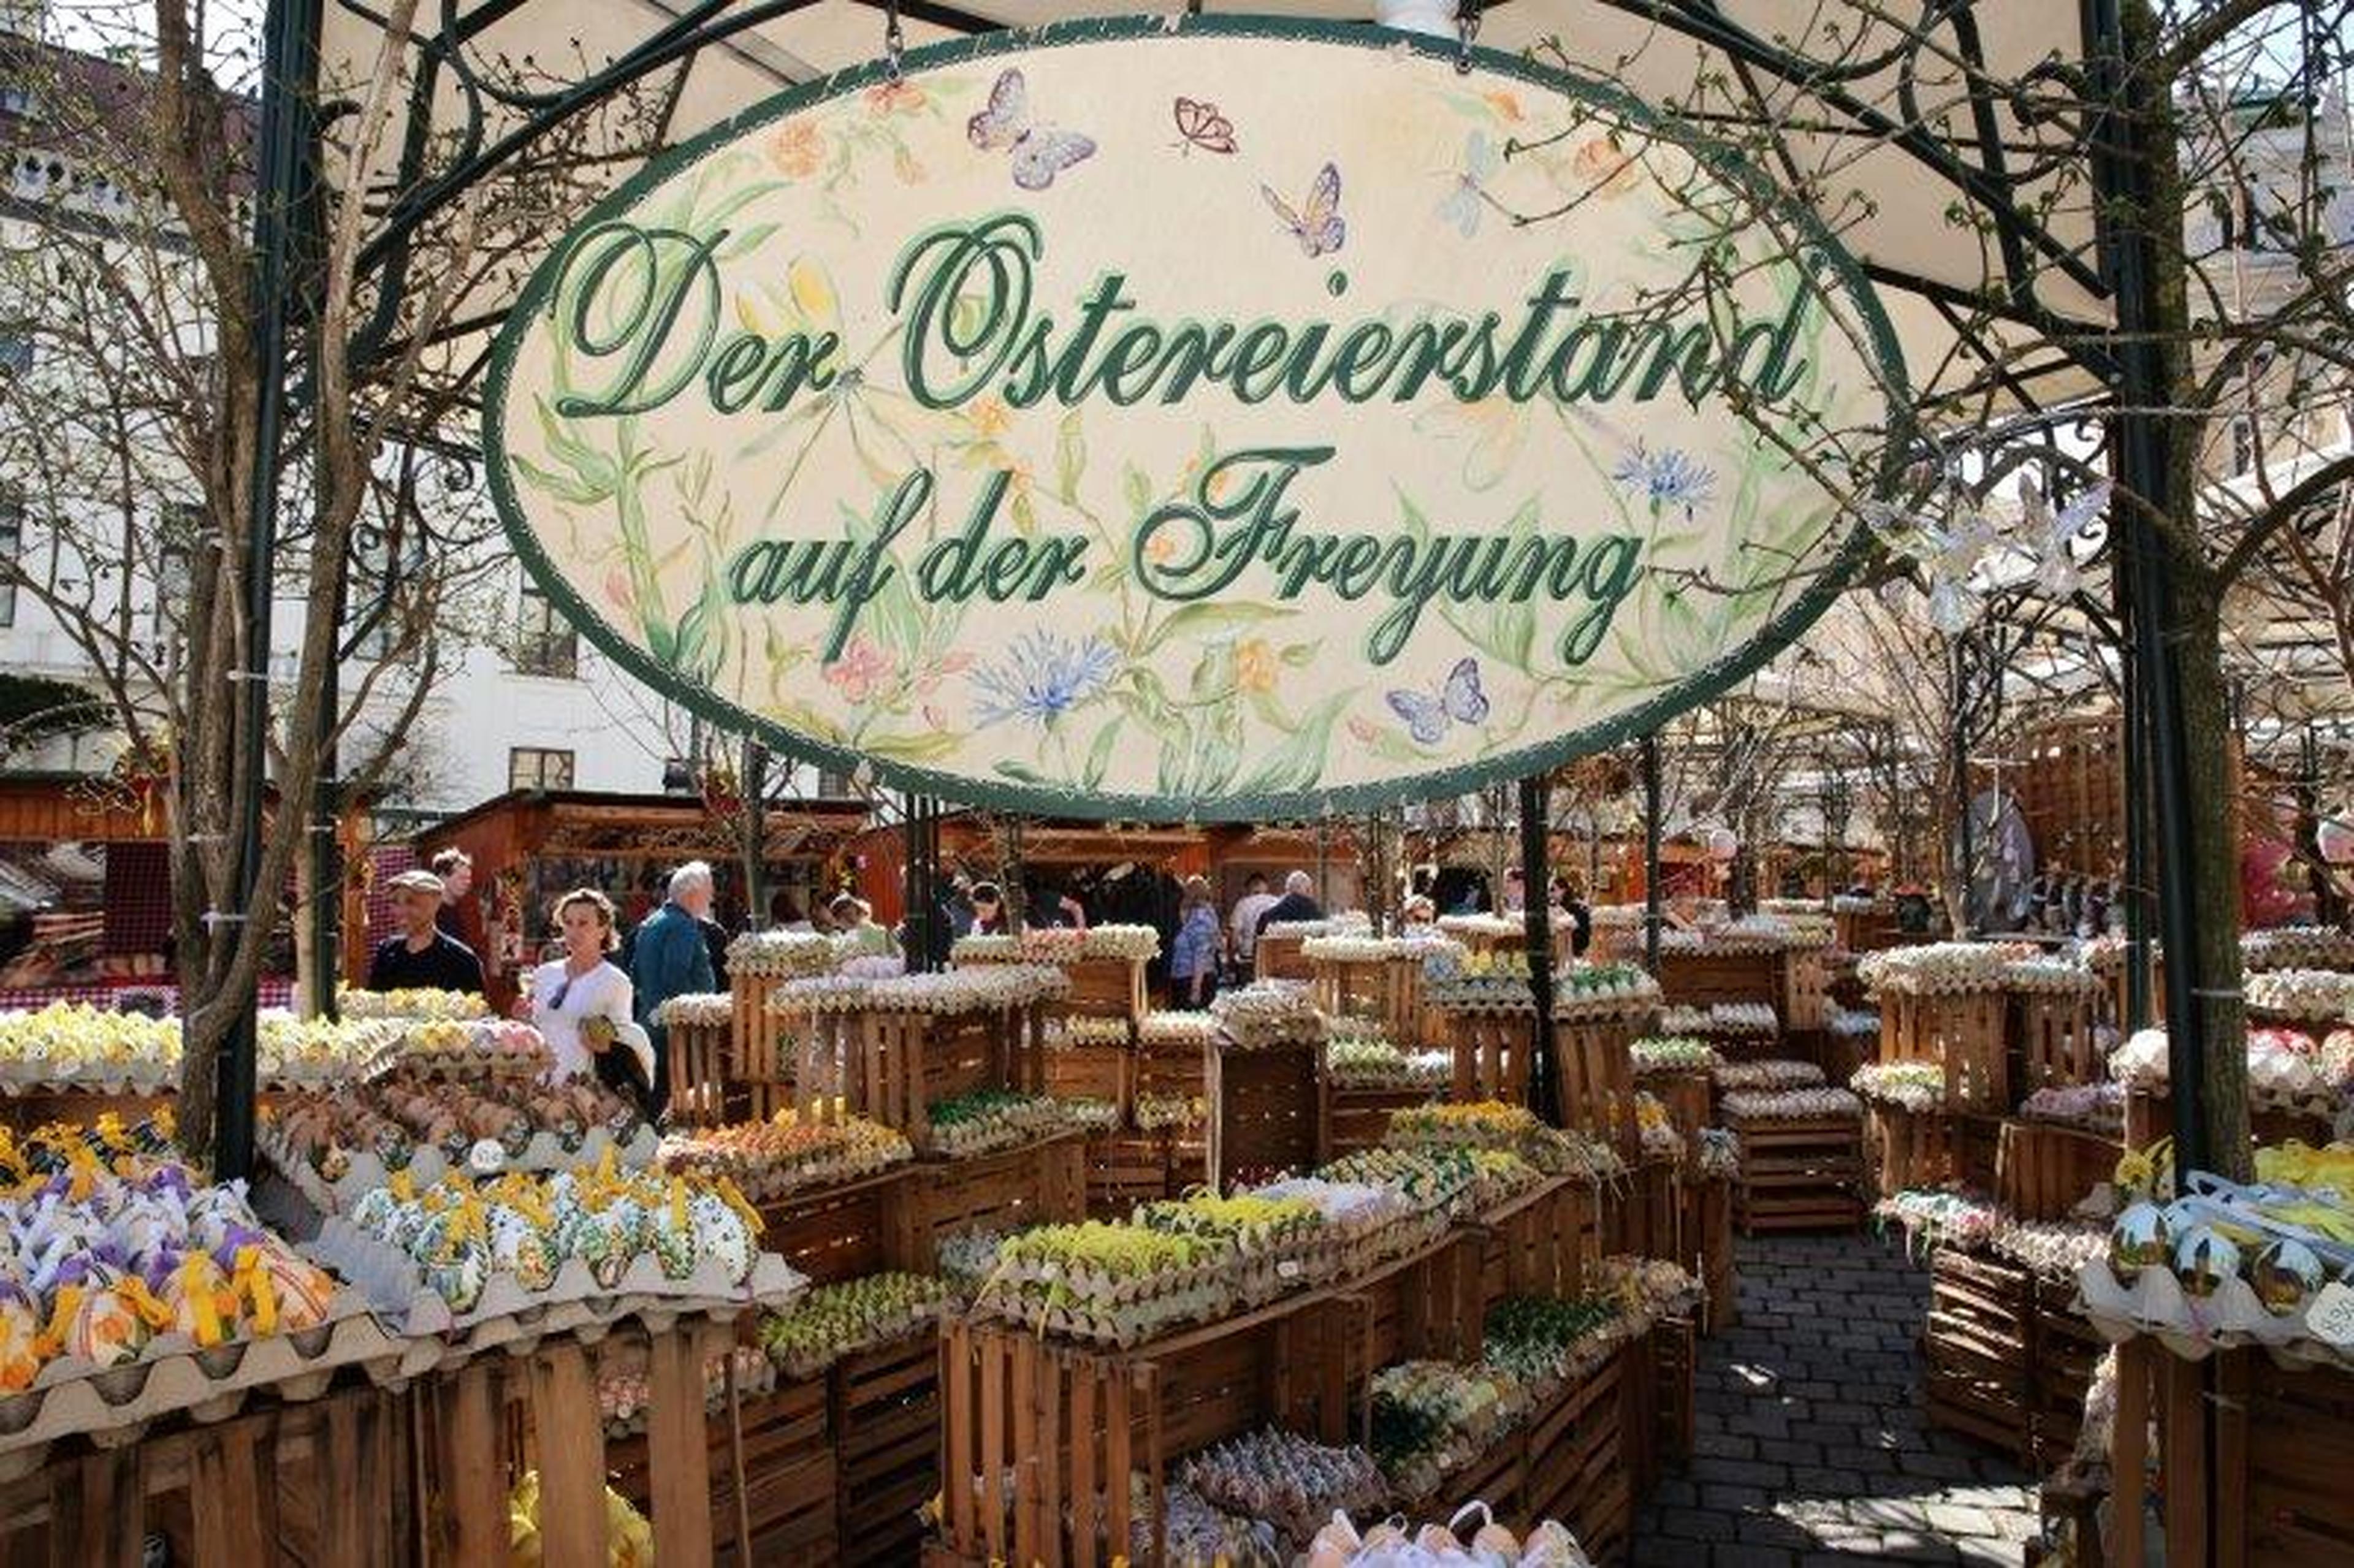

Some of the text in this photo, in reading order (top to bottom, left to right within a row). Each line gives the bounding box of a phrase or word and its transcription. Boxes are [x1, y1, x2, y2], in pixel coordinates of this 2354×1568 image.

[547, 212, 1810, 418] Der Ostereierstand
[731, 445, 1647, 666] auf der Freyung
